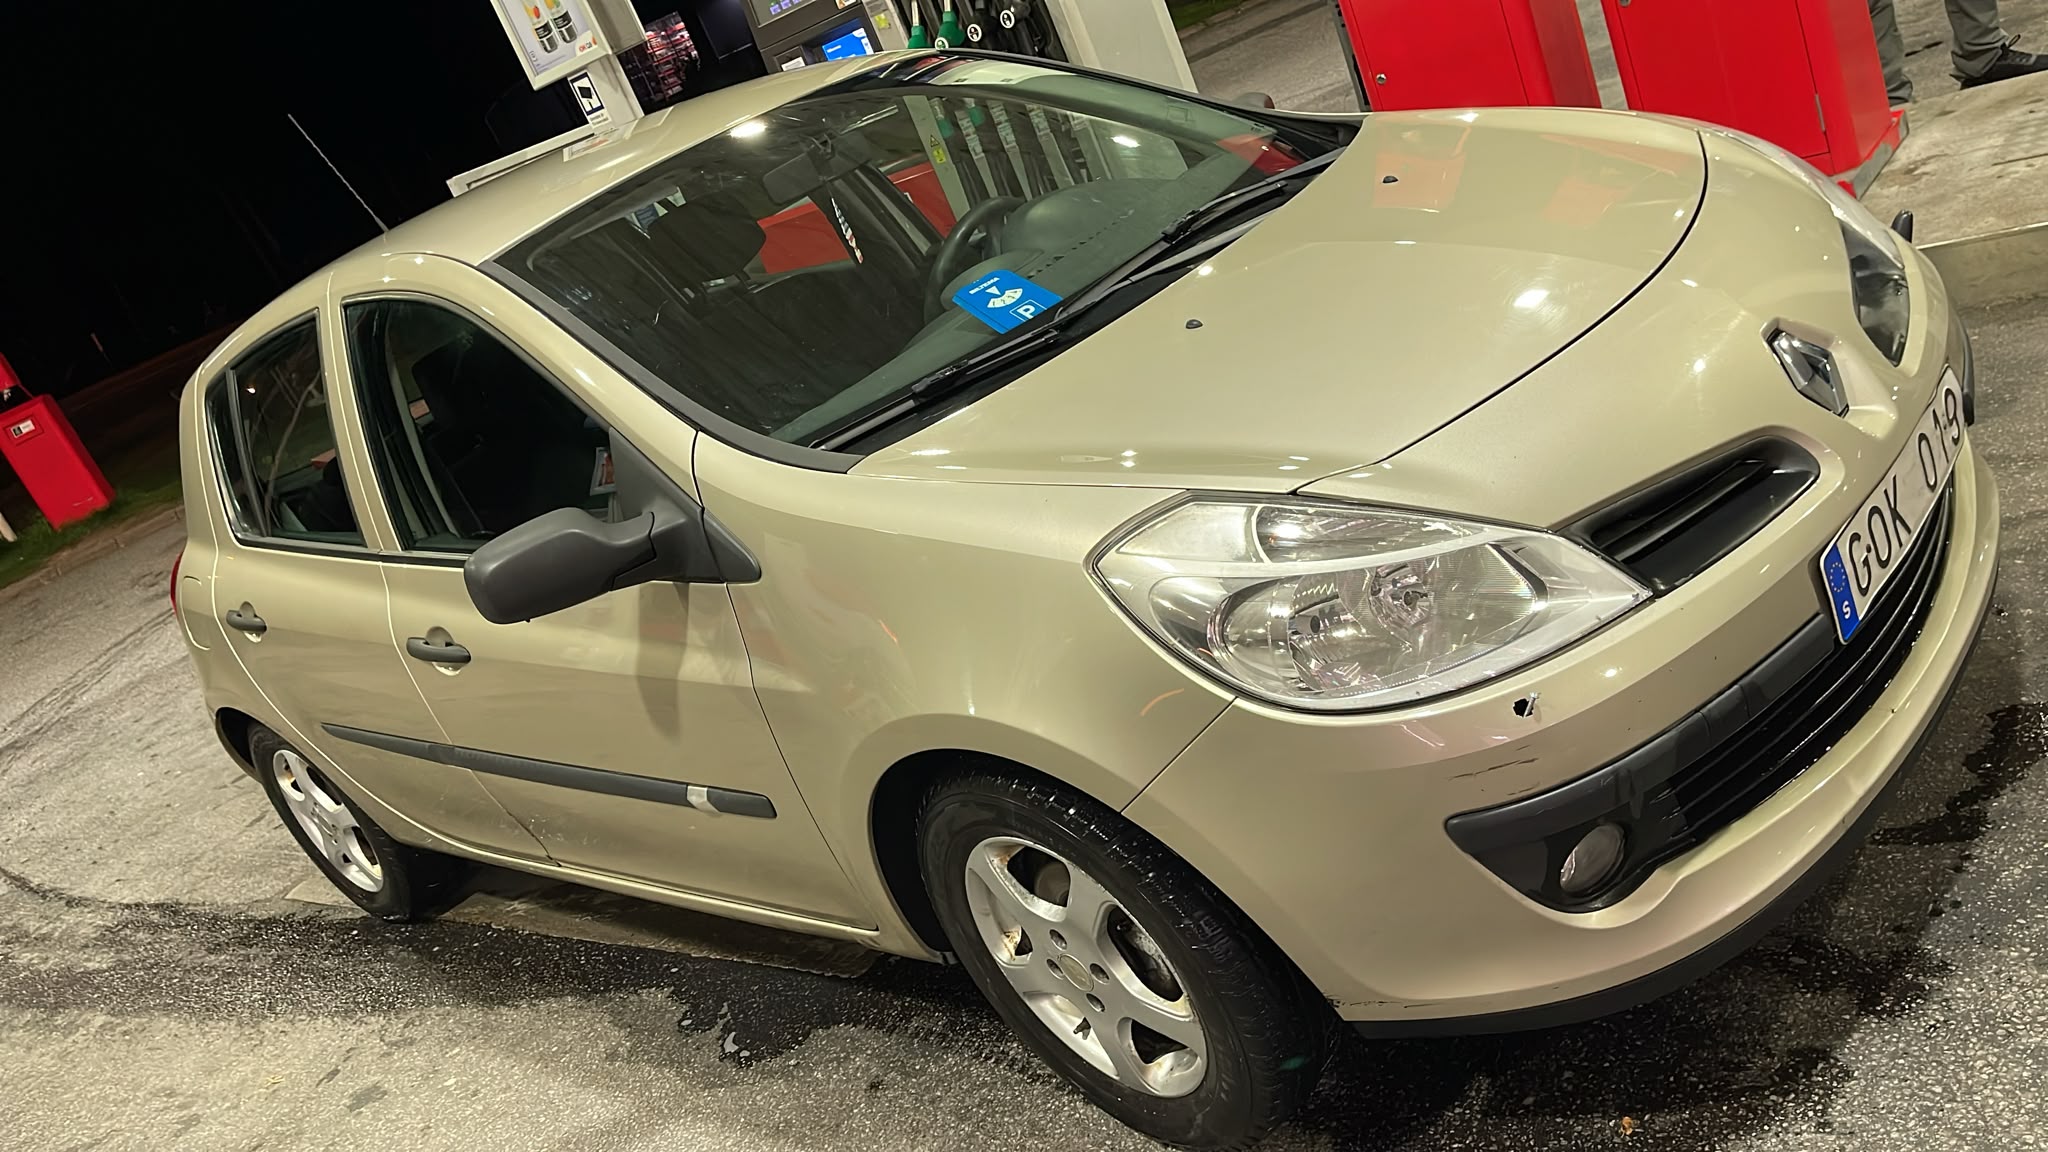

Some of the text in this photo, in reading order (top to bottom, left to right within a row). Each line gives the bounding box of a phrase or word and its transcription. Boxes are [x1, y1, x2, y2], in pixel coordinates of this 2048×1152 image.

[1017, 304, 1036, 319] P
[1849, 387, 1960, 597] GOK 019
[1842, 600, 1851, 620] S
